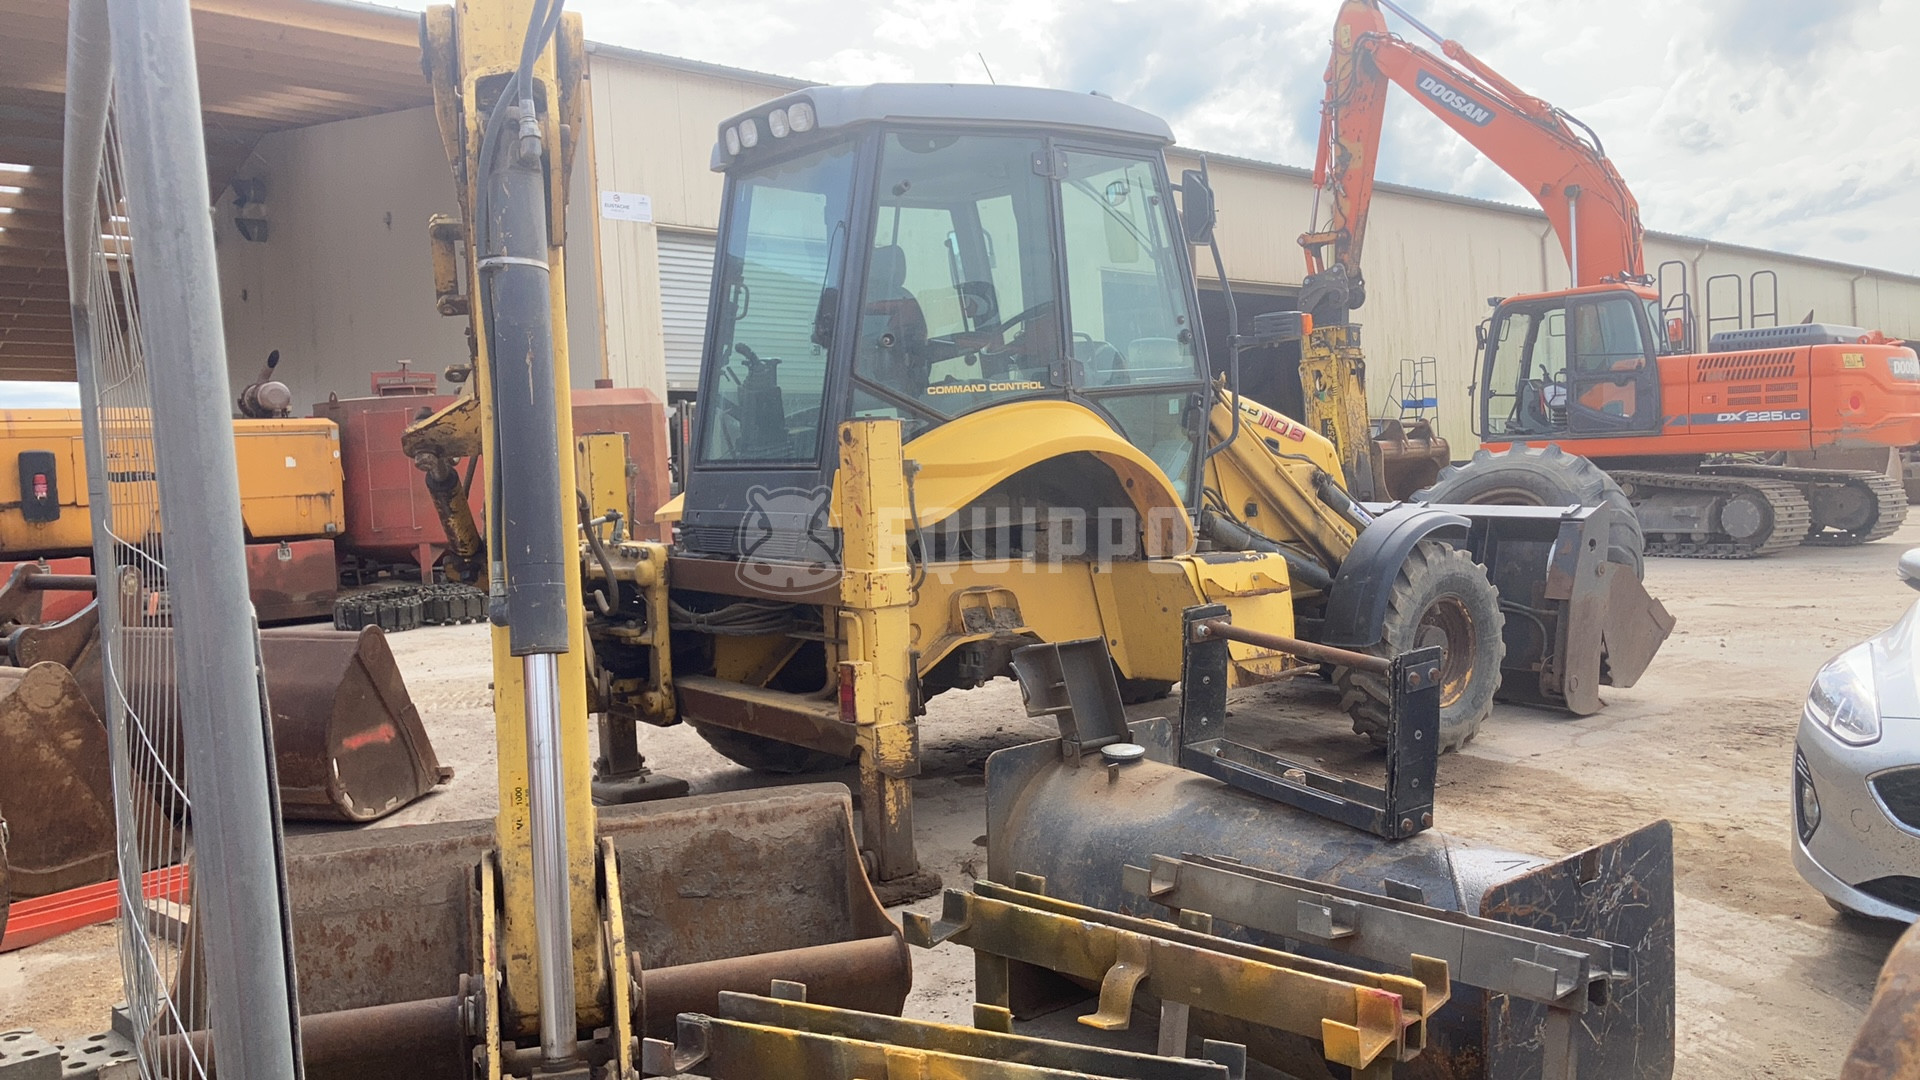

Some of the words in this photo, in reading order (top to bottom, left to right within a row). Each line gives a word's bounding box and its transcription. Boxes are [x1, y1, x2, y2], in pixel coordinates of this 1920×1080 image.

[1420, 77, 1489, 123] DOOSAN
[604, 202, 630, 210] EUSTACHE
[927, 384, 987, 395] COMMAND
[989, 381, 1045, 392] CONTROL
